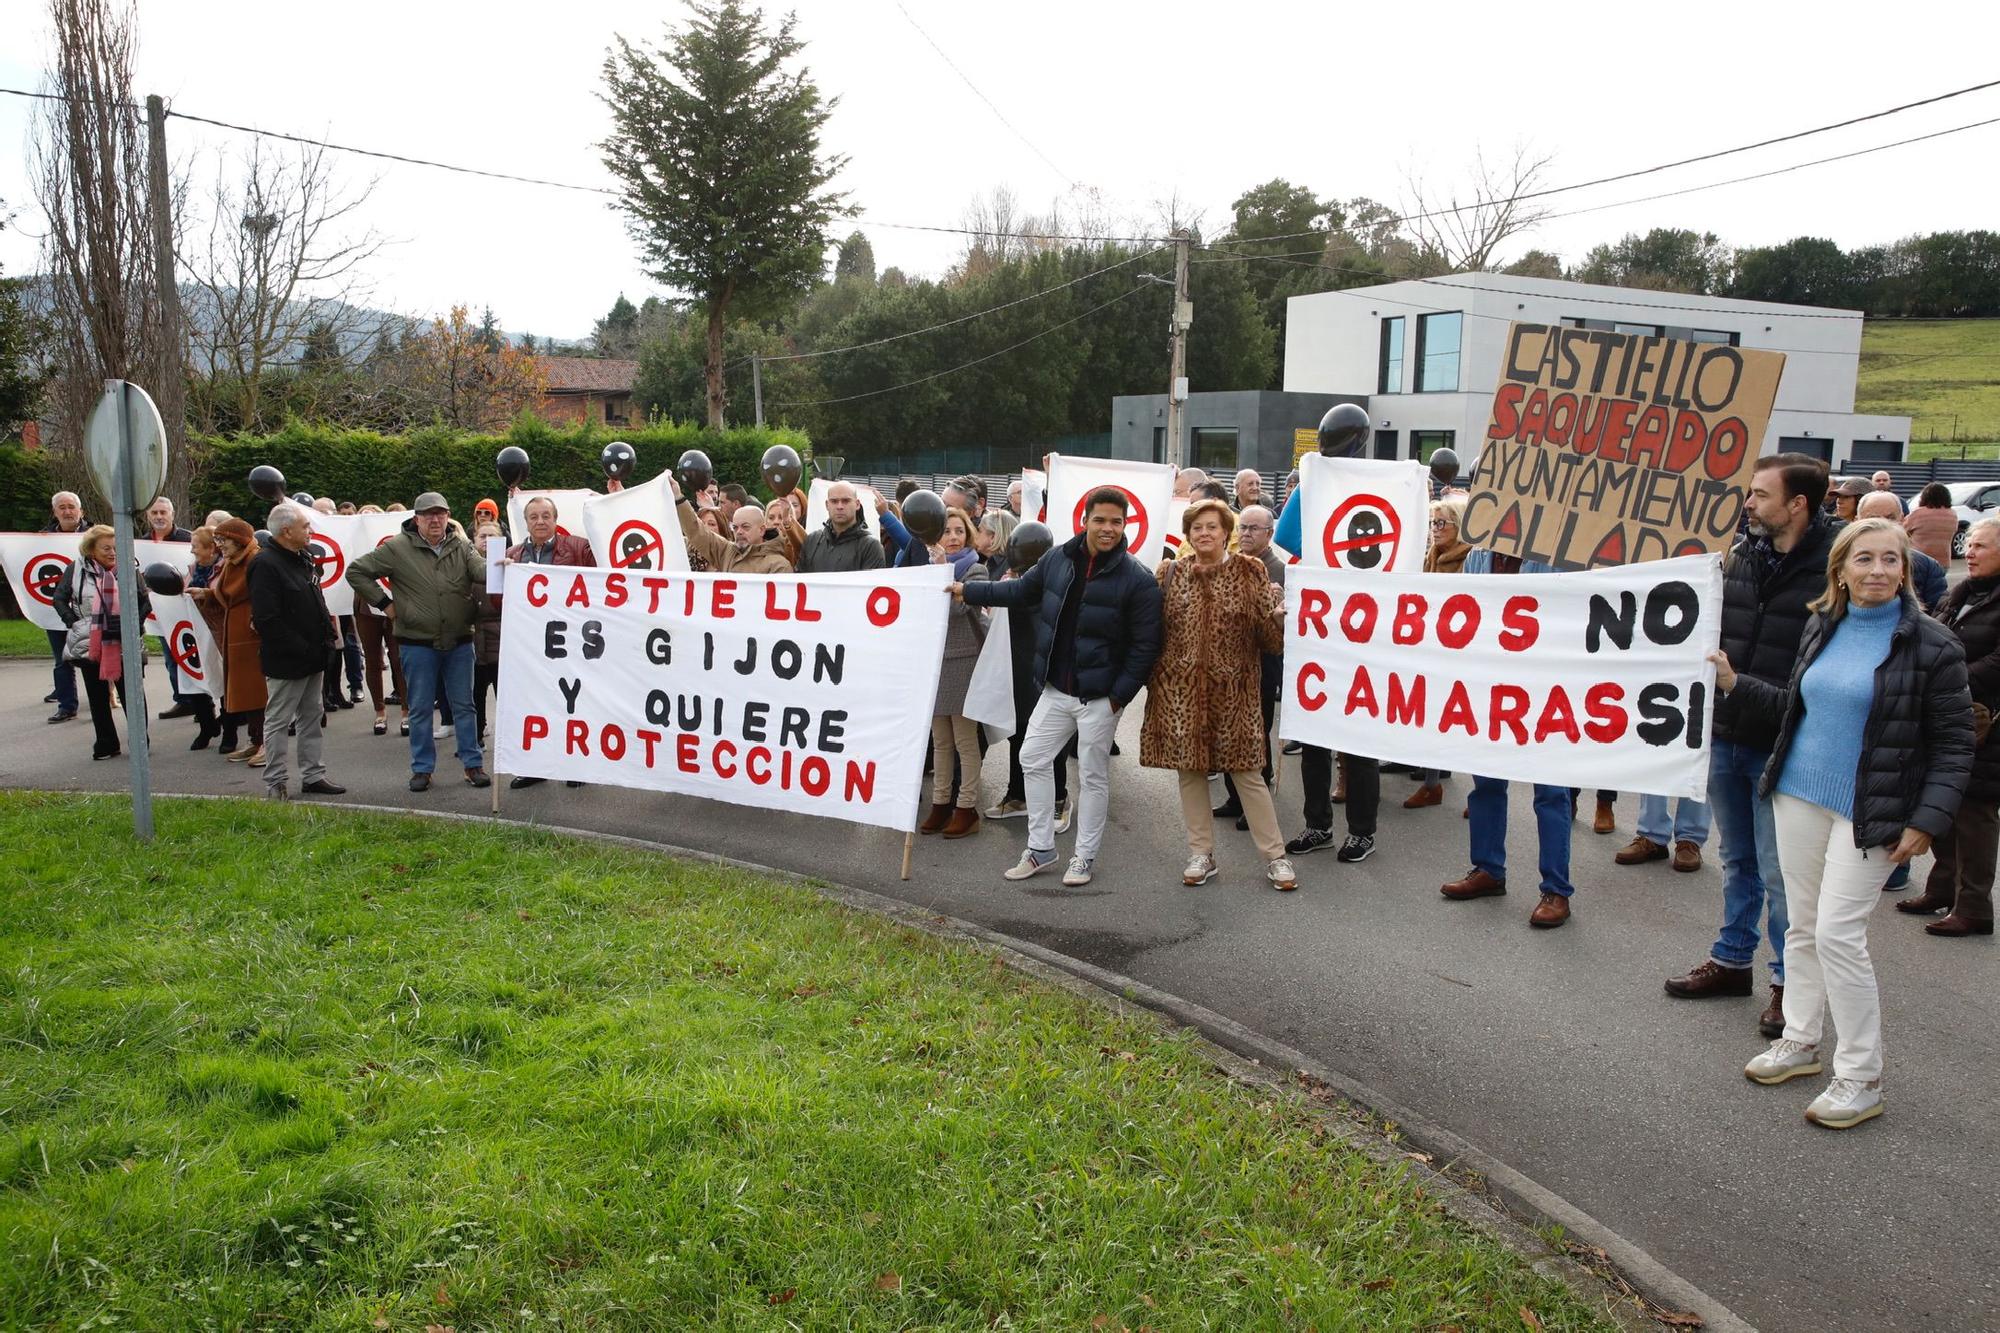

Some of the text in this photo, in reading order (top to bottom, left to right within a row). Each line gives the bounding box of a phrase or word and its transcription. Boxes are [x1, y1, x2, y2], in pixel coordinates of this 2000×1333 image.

[1506, 323, 1744, 413] CASTIELLO
[1487, 382, 1749, 481] SAQUEADO
[1473, 440, 1746, 538] AYUNTAMIENTO
[544, 620, 845, 686] ES GIJON
[1298, 580, 1700, 654] ROBOS NO
[522, 714, 876, 804] PROTECCION
[558, 677, 848, 754] Y QUIERE
